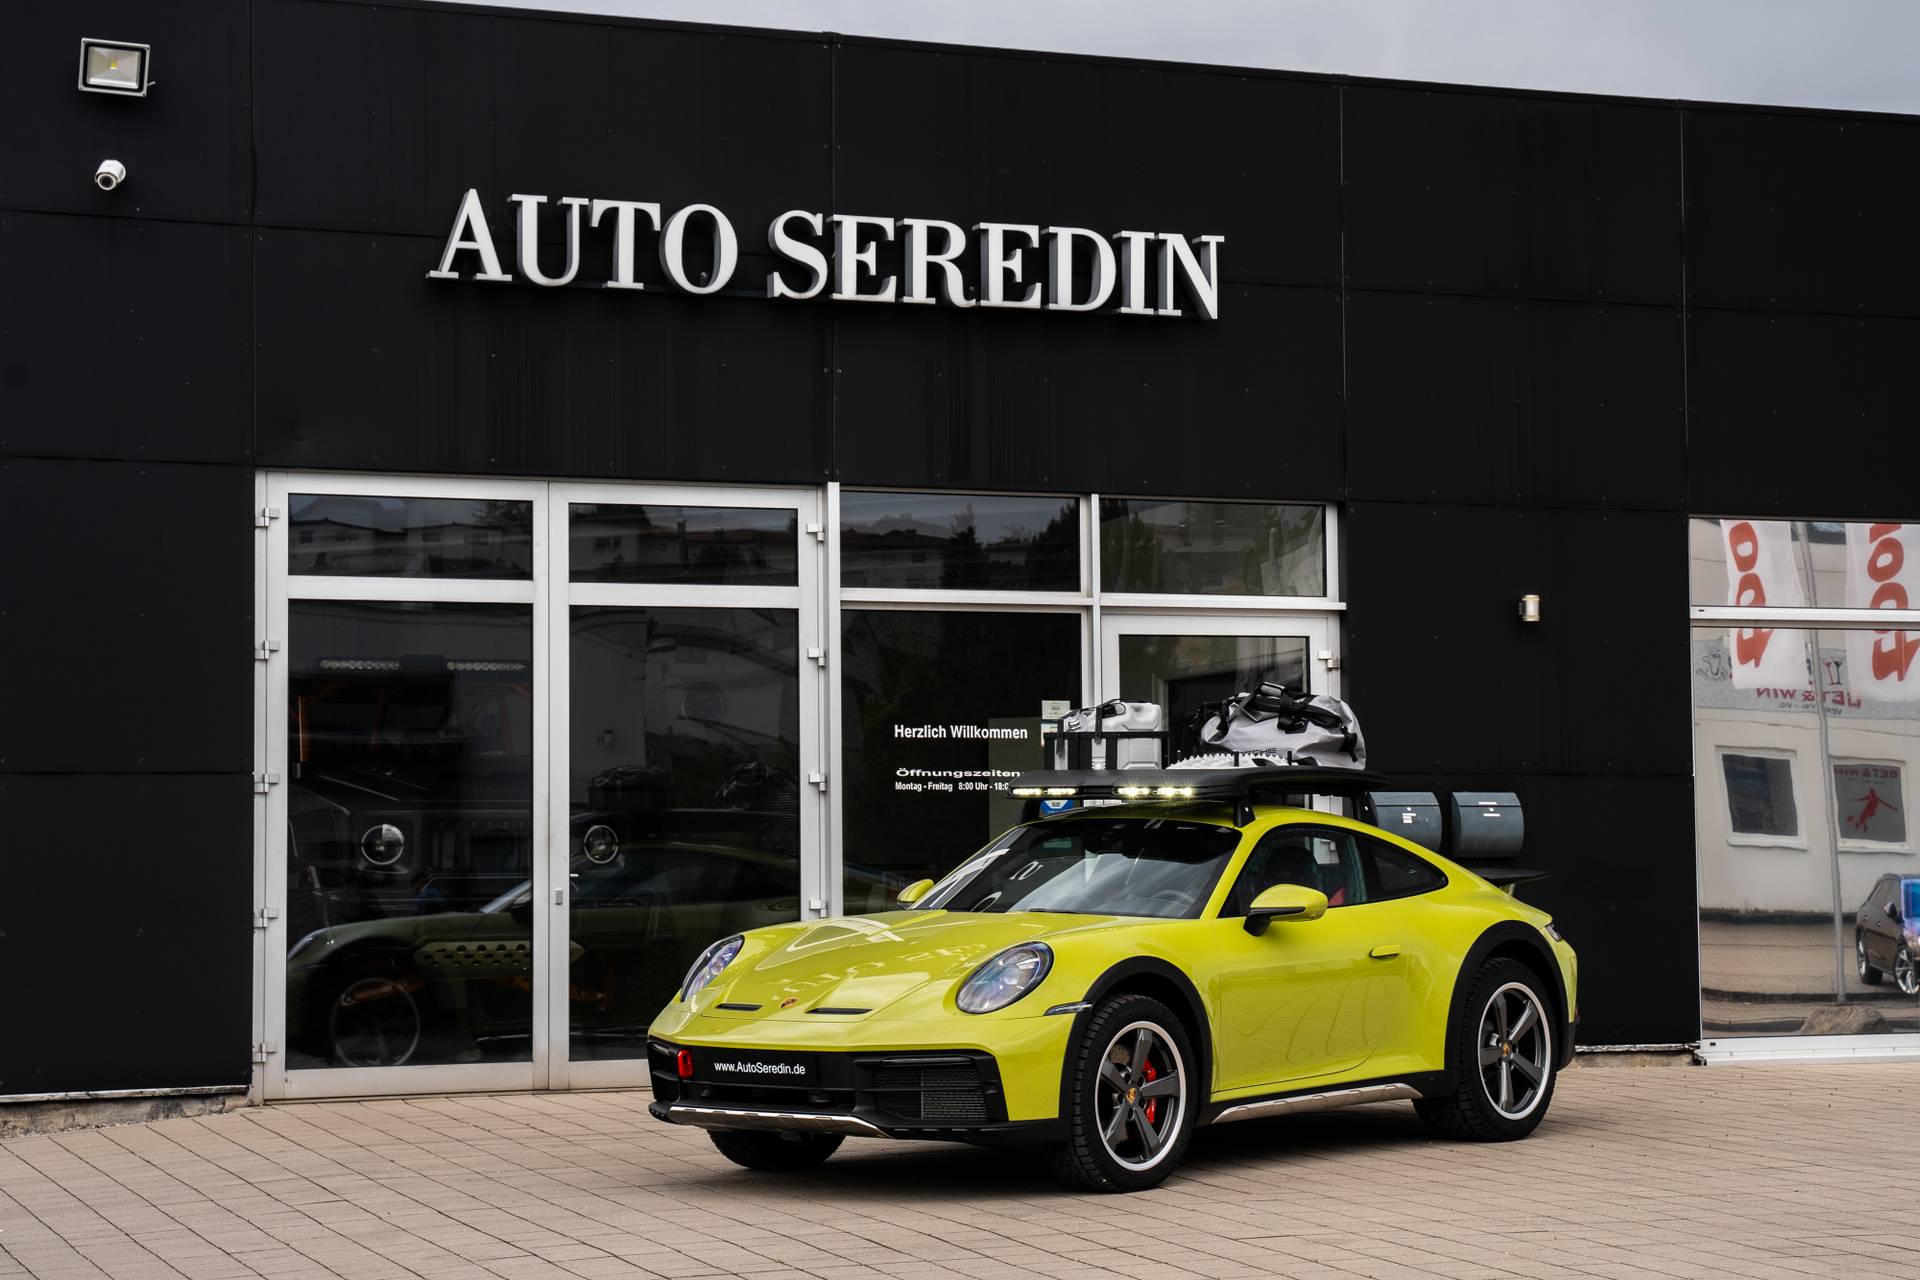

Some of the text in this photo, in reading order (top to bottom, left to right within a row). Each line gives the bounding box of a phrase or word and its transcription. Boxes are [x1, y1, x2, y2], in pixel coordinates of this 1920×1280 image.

[426, 188, 1225, 320] AUTO SEREDIN
[894, 725, 1029, 740] Herzlich Willkommen
[895, 781, 922, 792] Montag
[928, 782, 953, 792] Freitag
[958, 782, 974, 791] 8:00
[975, 782, 988, 791] Uhr
[994, 782, 1009, 791] 18:0
[714, 1062, 806, 1074] www.AutoSeredin.de
